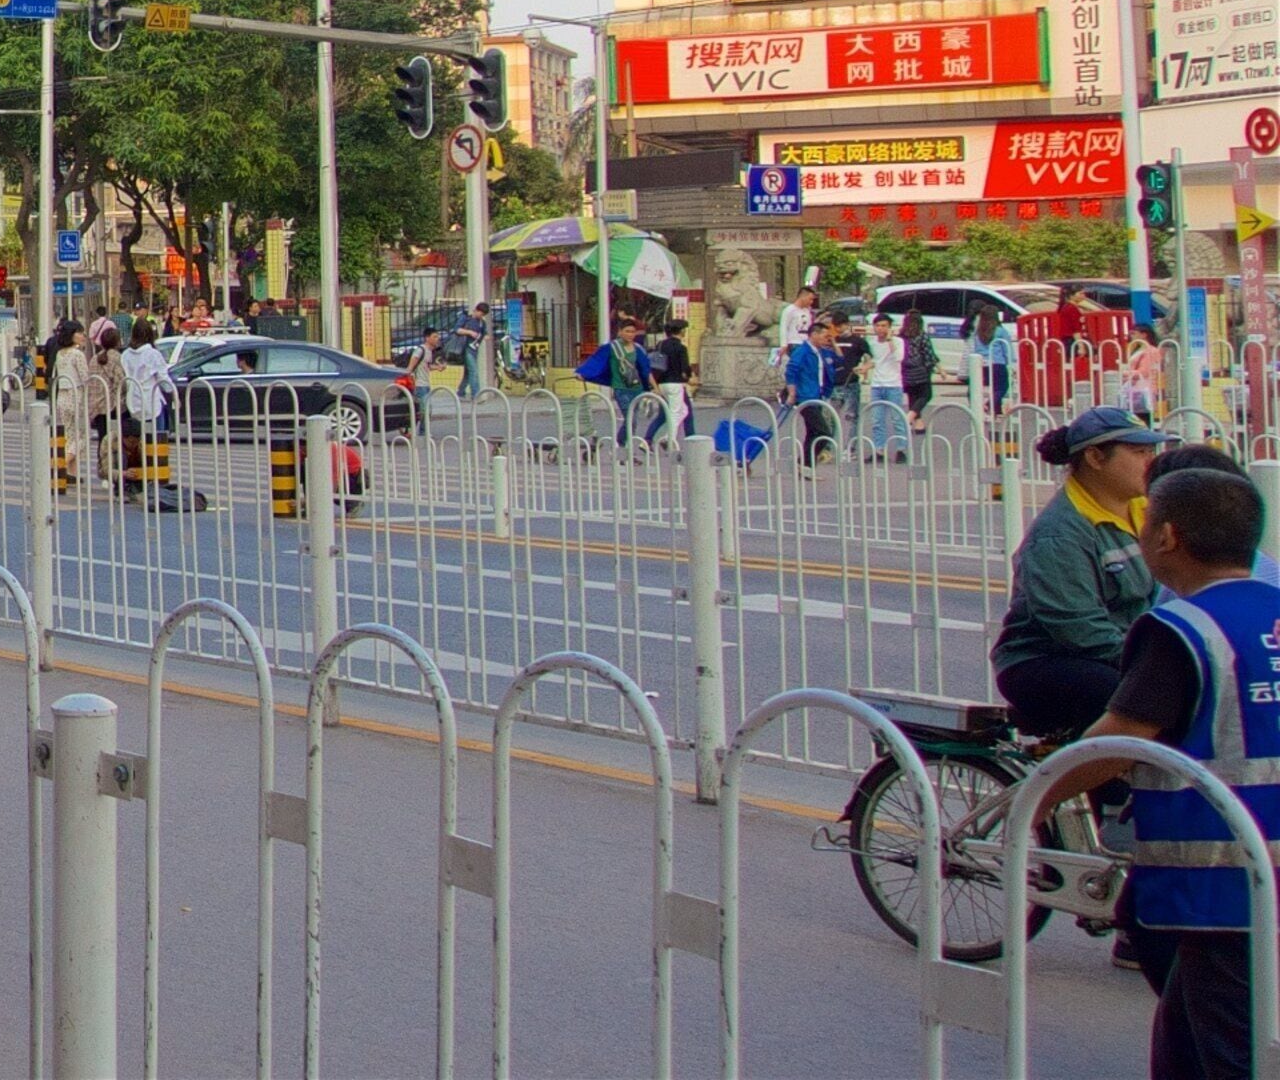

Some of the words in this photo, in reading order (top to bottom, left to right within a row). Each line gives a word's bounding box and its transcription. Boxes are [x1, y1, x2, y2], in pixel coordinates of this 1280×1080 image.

[685, 36, 804, 69] 搜款网
[845, 27, 972, 57] 大西豪
[705, 69, 791, 93] VVIC
[846, 55, 972, 84] 网批城
[780, 139, 961, 166] 大西豪网络批发城
[1007, 127, 1124, 161] 搜款网
[874, 167, 966, 188] 创业首站
[1024, 160, 1112, 186] VVIC
